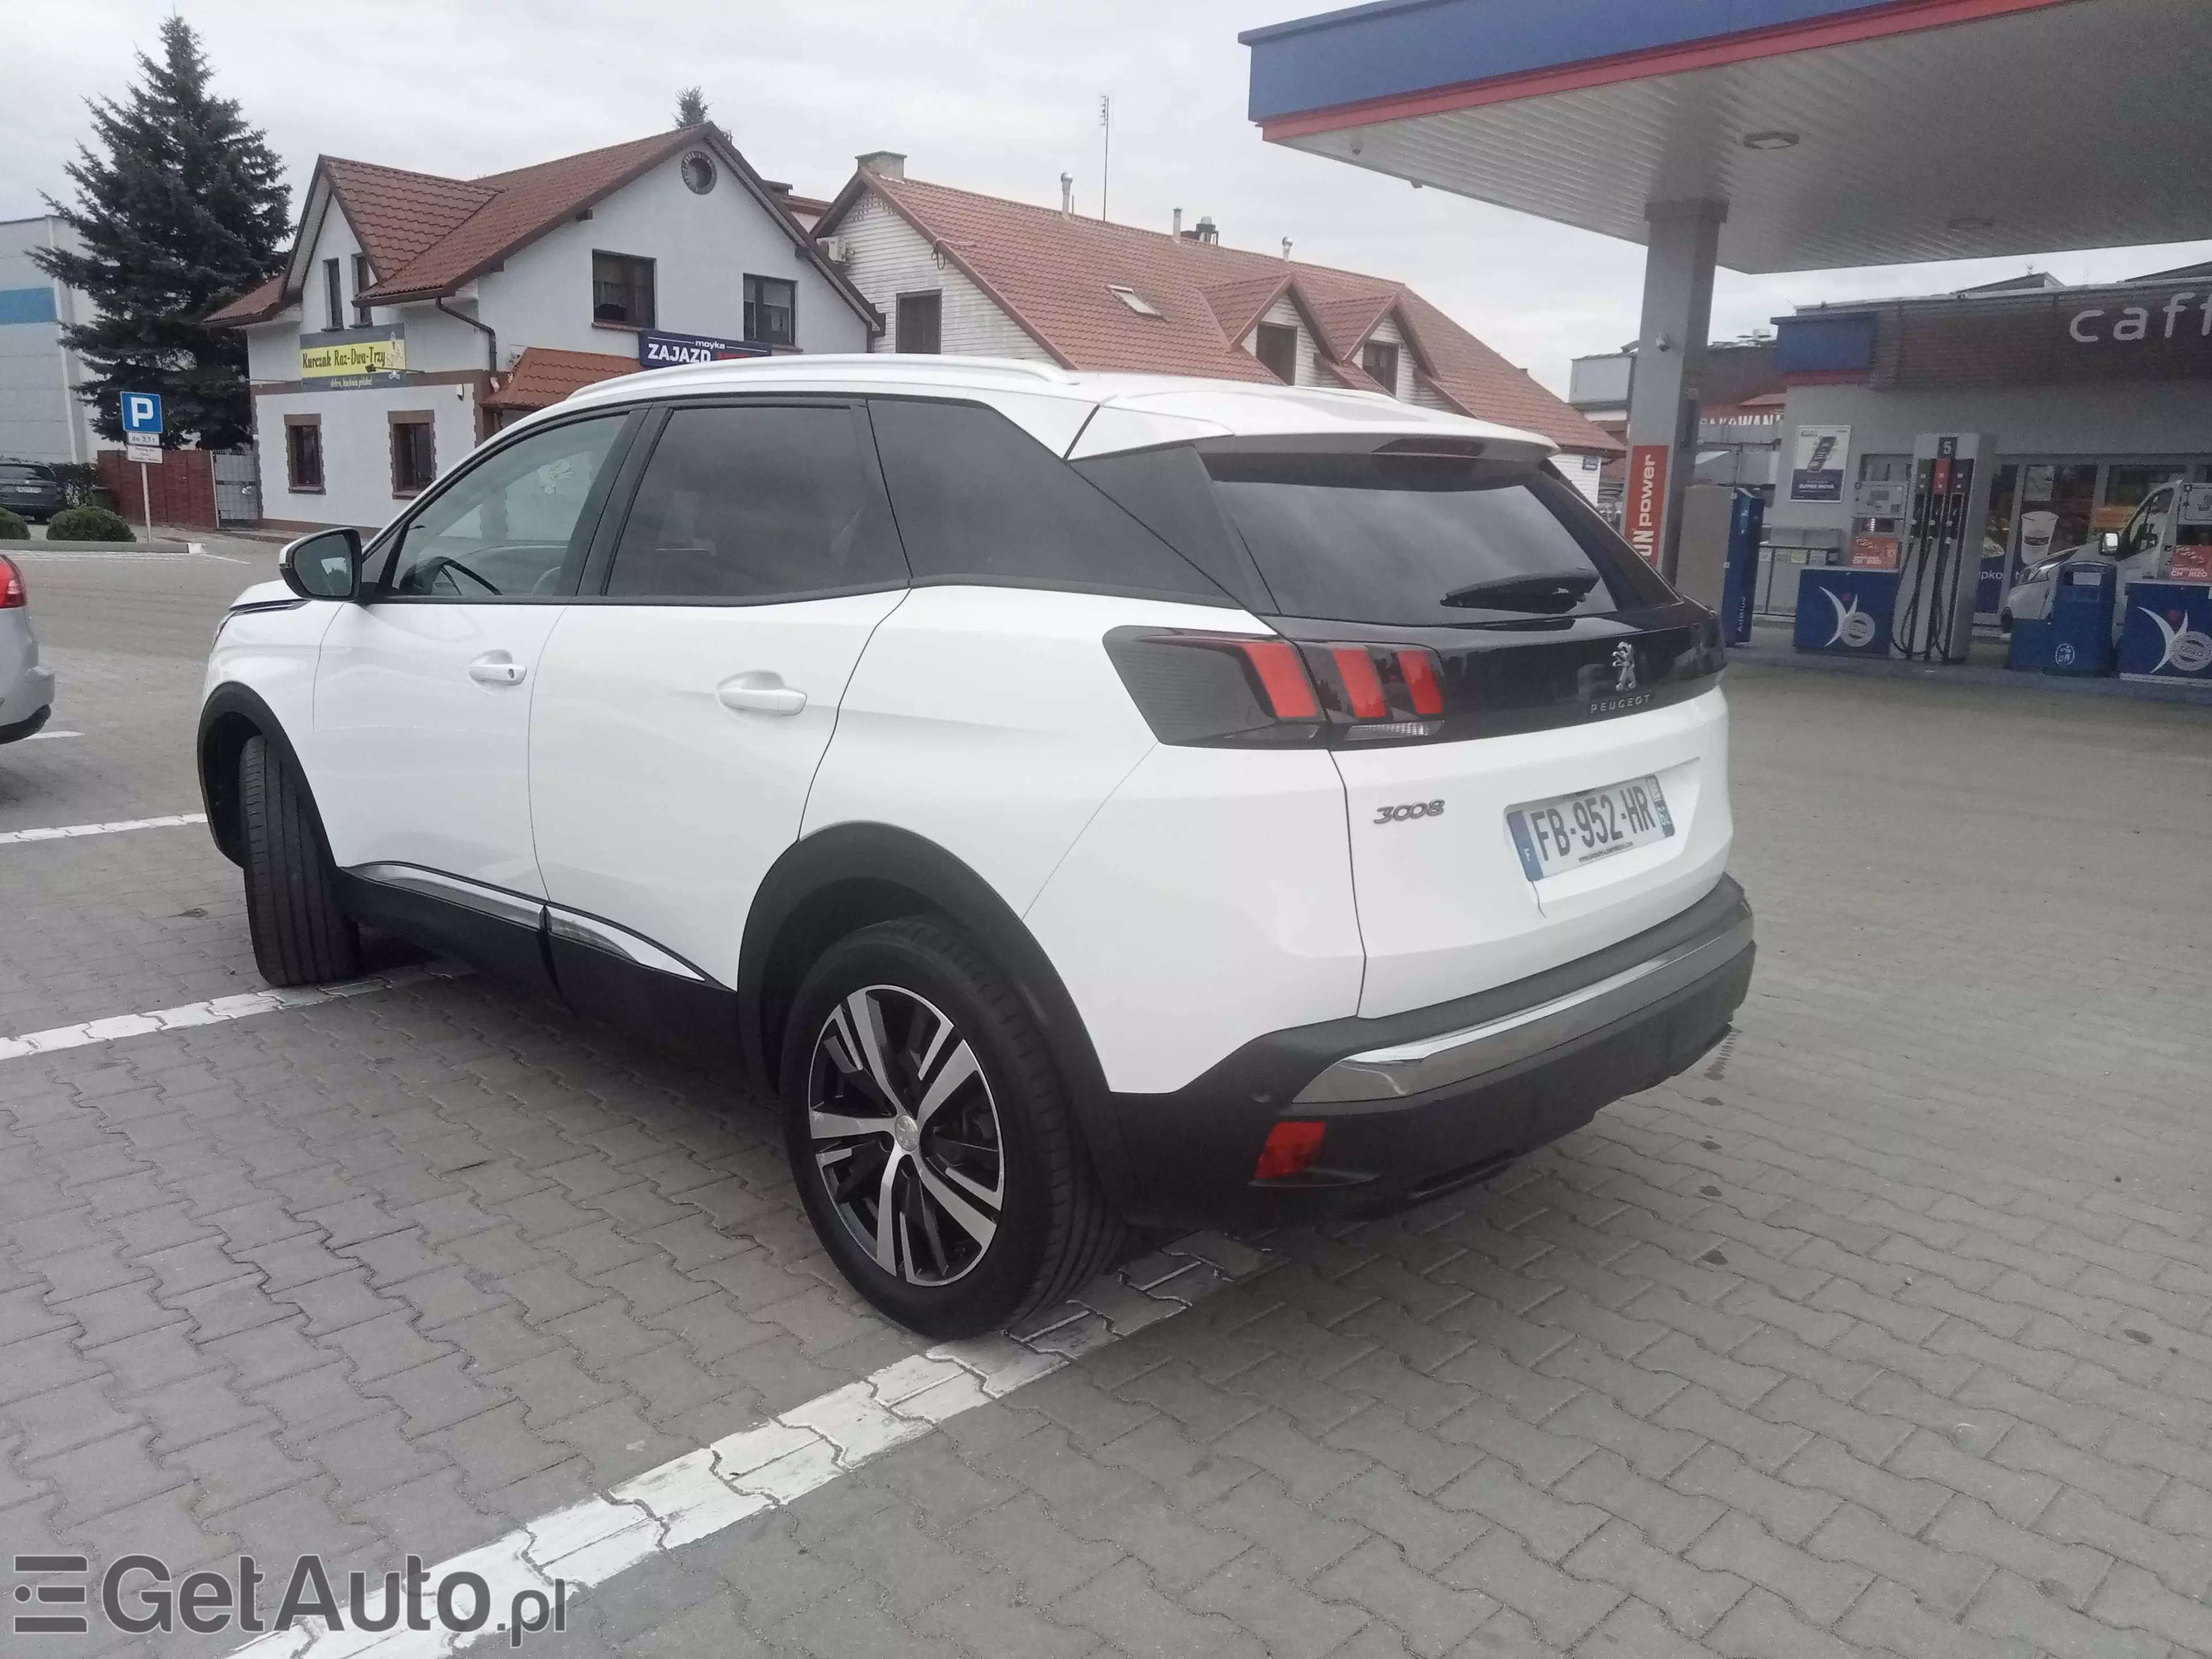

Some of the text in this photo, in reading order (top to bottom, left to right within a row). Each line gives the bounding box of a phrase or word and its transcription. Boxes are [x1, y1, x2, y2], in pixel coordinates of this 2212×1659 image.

[647, 343, 711, 364] ZAJAZD
[695, 340, 725, 349] moyka
[302, 346, 385, 369] Kurczak Raz-Dwa-Trzy
[131, 397, 154, 427] P
[1943, 441, 1952, 454] 5
[1639, 454, 1656, 527] power
[1589, 694, 1651, 714] PEUGEOT
[1373, 799, 1445, 824] 3008
[1530, 785, 1657, 861] FB-952-HR
[1523, 848, 1531, 862] F
